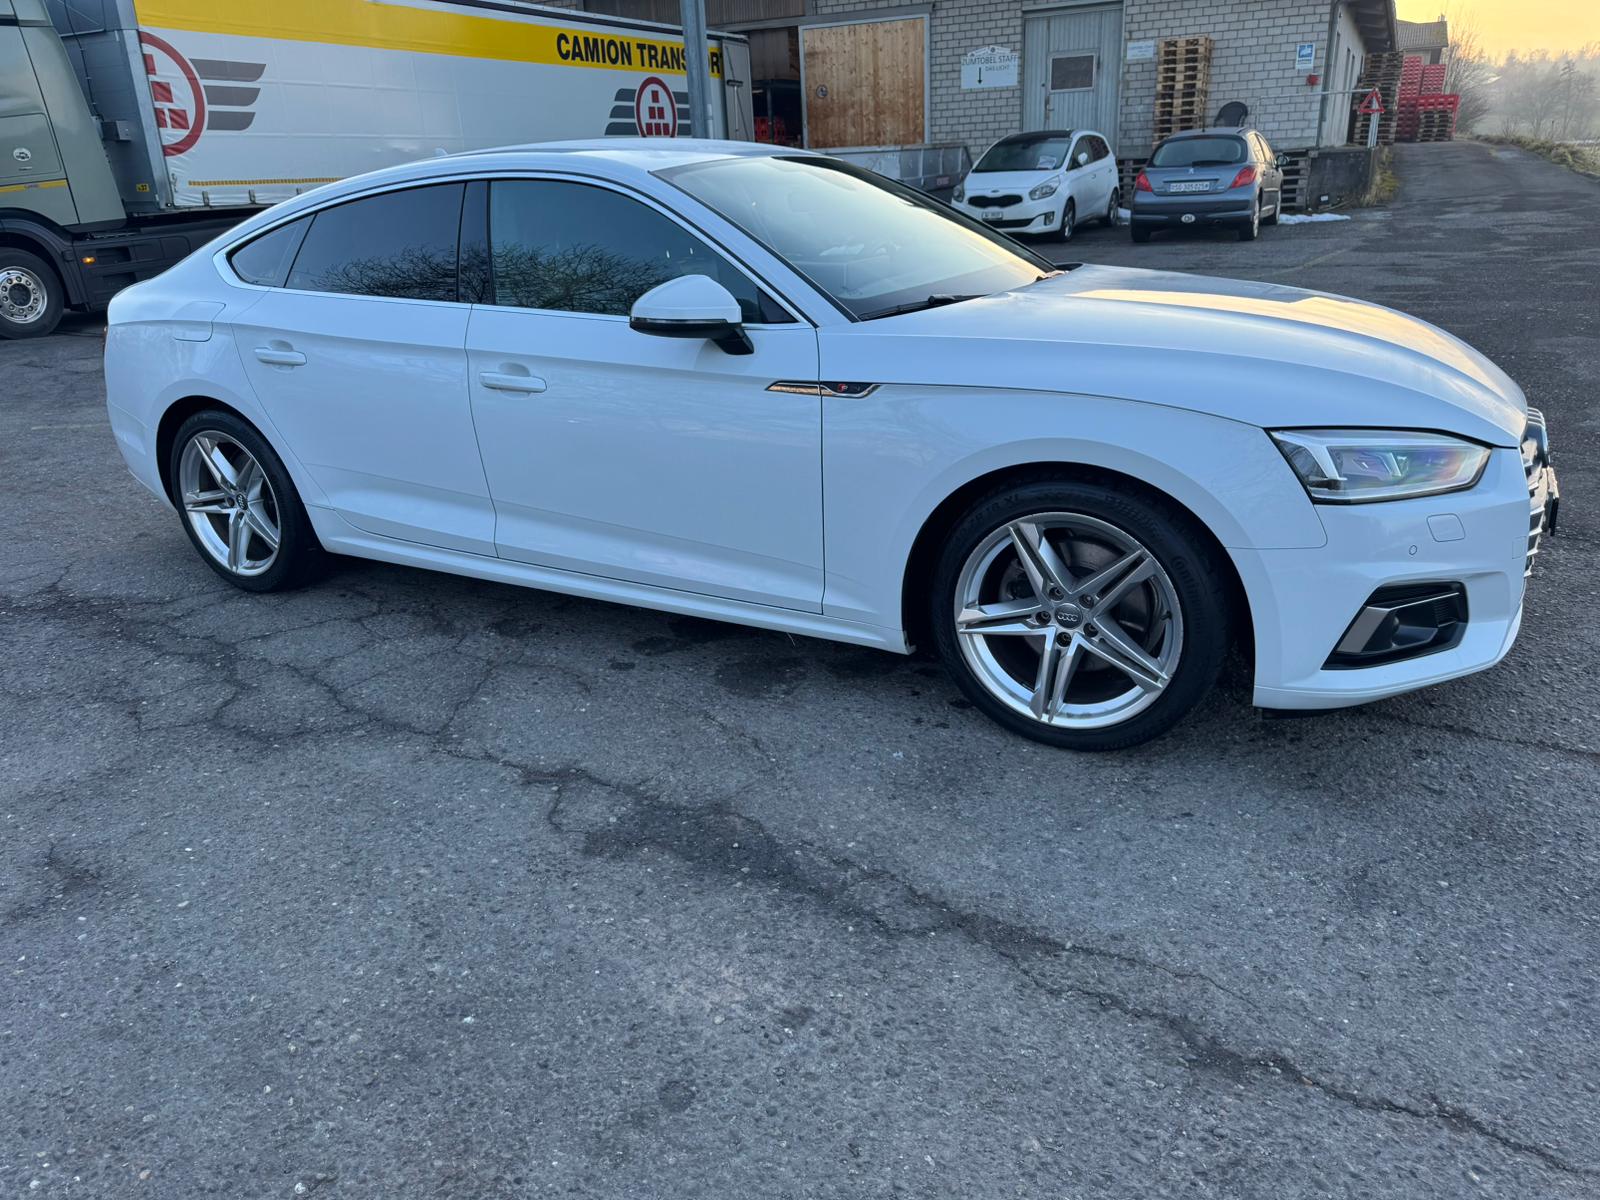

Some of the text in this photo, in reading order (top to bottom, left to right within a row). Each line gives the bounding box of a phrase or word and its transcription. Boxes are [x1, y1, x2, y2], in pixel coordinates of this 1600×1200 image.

[556, 32, 632, 66] CAMION
[961, 54, 1018, 65] ZUMTOBEL STAFF
